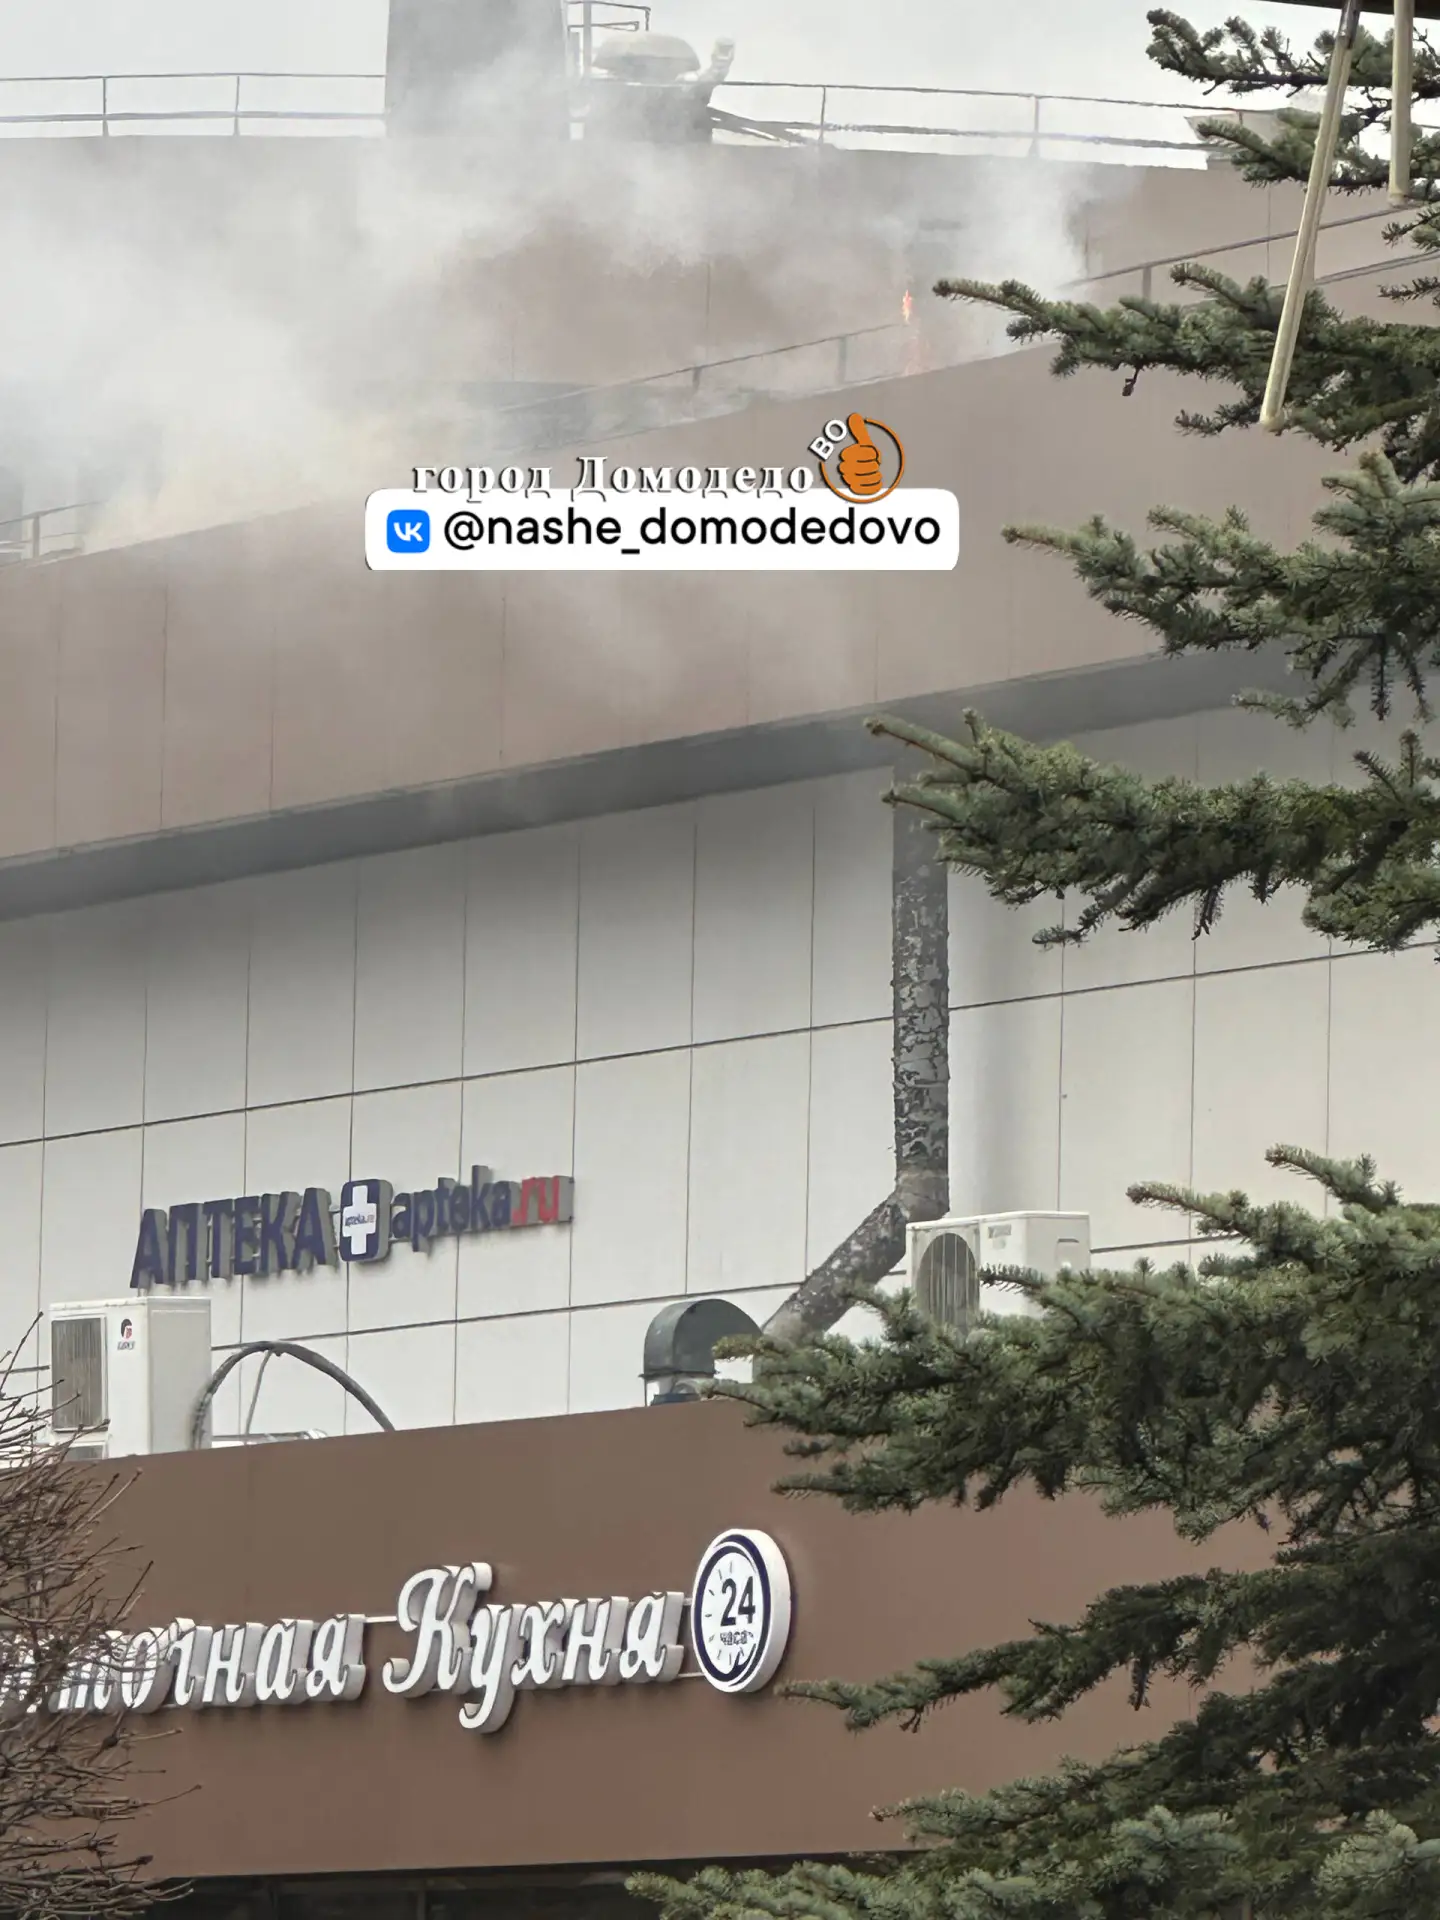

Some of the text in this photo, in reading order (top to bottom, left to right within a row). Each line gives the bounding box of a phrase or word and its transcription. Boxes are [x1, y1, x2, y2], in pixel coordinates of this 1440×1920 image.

[130, 1187, 337, 1289] АПТЕКА
[391, 1165, 564, 1253] apteka.ru
[0, 1563, 680, 1731] точная Кухня
[719, 1576, 757, 1627] 24
